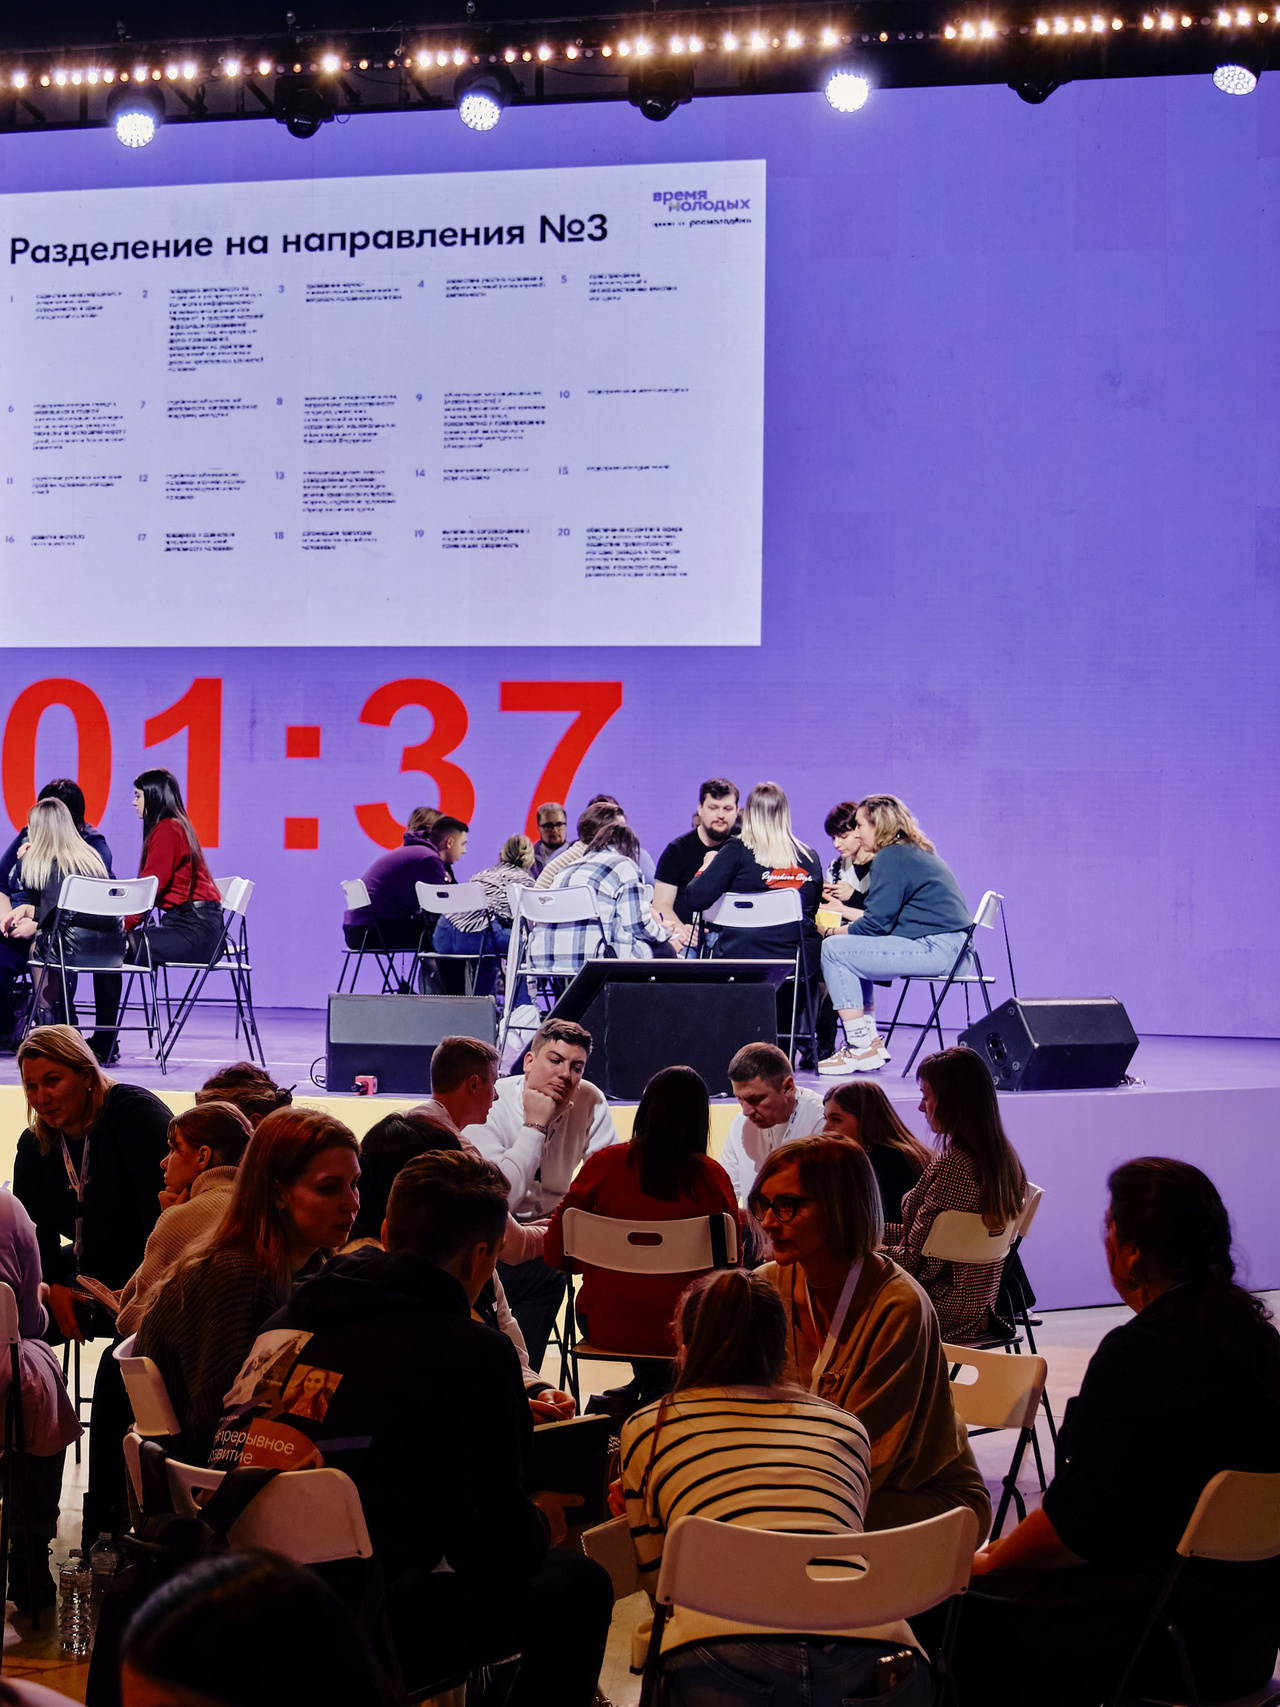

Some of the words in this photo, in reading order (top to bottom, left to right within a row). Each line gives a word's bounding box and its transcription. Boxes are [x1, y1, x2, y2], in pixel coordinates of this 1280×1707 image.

[653, 189, 708, 206] время
[668, 198, 751, 213] молодых
[10, 237, 213, 267] Разделение
[226, 234, 269, 256] на
[282, 225, 525, 258] направления
[539, 213, 608, 244] №3
[416, 279, 425, 289] 4
[560, 274, 569, 285] 5
[140, 289, 149, 299] 2
[277, 284, 285, 294] 3
[415, 392, 424, 403] 9
[558, 389, 571, 400] 10
[139, 399, 147, 410] 7
[275, 396, 284, 406] 8
[7, 403, 15, 414] 6
[274, 470, 286, 481] 13
[415, 468, 426, 478] 14
[557, 465, 570, 476] 15
[6, 476, 14, 486] 11
[138, 473, 149, 483] 12
[137, 532, 148, 543] 17
[273, 530, 285, 541] 18
[414, 529, 425, 539] 19
[557, 527, 571, 538] 20
[4, 534, 16, 545] 16
[0, 677, 623, 850] 01:37
